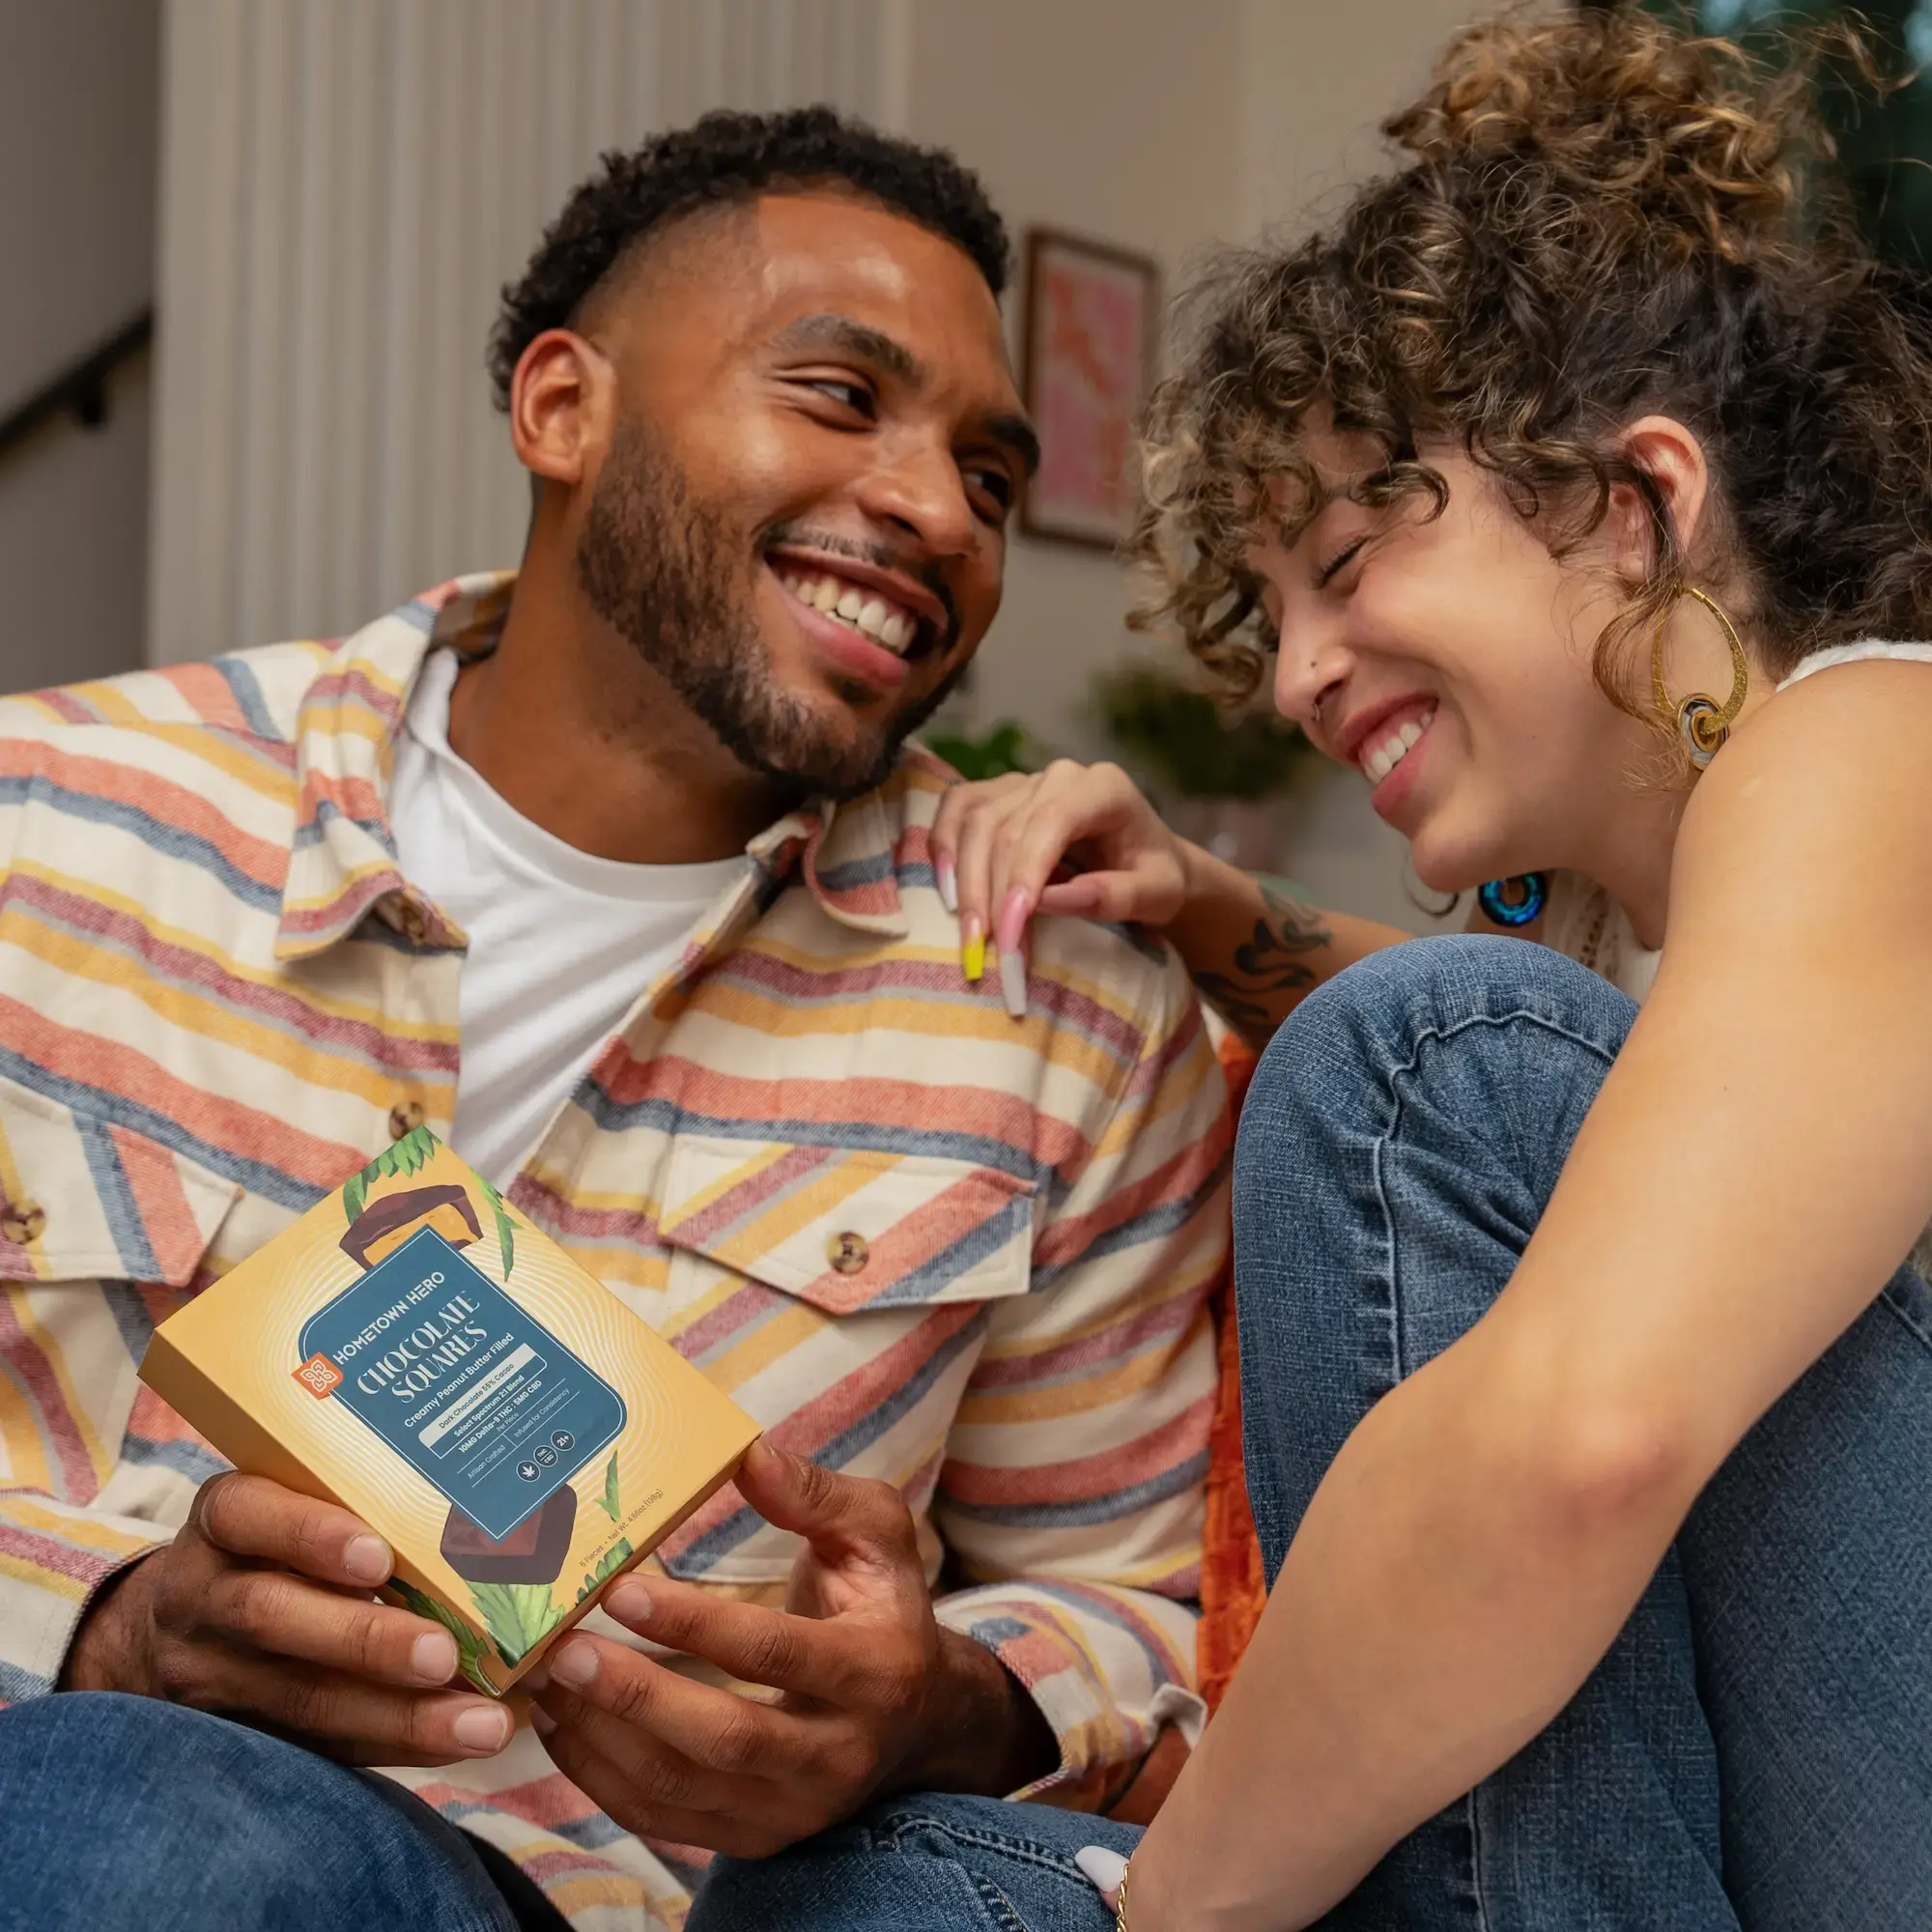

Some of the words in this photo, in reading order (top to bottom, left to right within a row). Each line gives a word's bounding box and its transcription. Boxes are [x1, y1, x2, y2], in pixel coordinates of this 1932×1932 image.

[332, 1300, 410, 1365] HOMETOWN
[406, 1271, 445, 1305] HERO
[357, 1291, 480, 1394] CHOCOLATE
[391, 1321, 487, 1404] SQUARES
[404, 1397, 440, 1428] Creamy
[436, 1372, 469, 1400] Peanut
[465, 1351, 493, 1376] Butter
[489, 1332, 515, 1354] Filled
[439, 1414, 456, 1429] Dark
[453, 1390, 484, 1416] Chocolate
[481, 1378, 497, 1392] 55%
[494, 1363, 515, 1381] Cacao
[453, 1419, 474, 1437] Select
[470, 1396, 501, 1422] Spectrum
[497, 1388, 509, 1399] 2:1
[505, 1374, 526, 1392] Blend
[458, 1435, 478, 1453] 10MG
[474, 1416, 500, 1439] Delta-9
[497, 1406, 513, 1419] THC
[512, 1391, 529, 1406] 5MG
[526, 1379, 542, 1394] CBD
[496, 1423, 506, 1433] Per
[503, 1412, 520, 1426] Piece
[513, 1419, 534, 1438] Infused
[530, 1413, 541, 1422] for
[538, 1387, 570, 1415] Consistency
[467, 1461, 487, 1480] Artisan
[484, 1443, 506, 1463] Crafted
[556, 1435, 570, 1447] 21+
[583, 1545, 605, 1564] Pieces
[608, 1529, 621, 1542] Net
